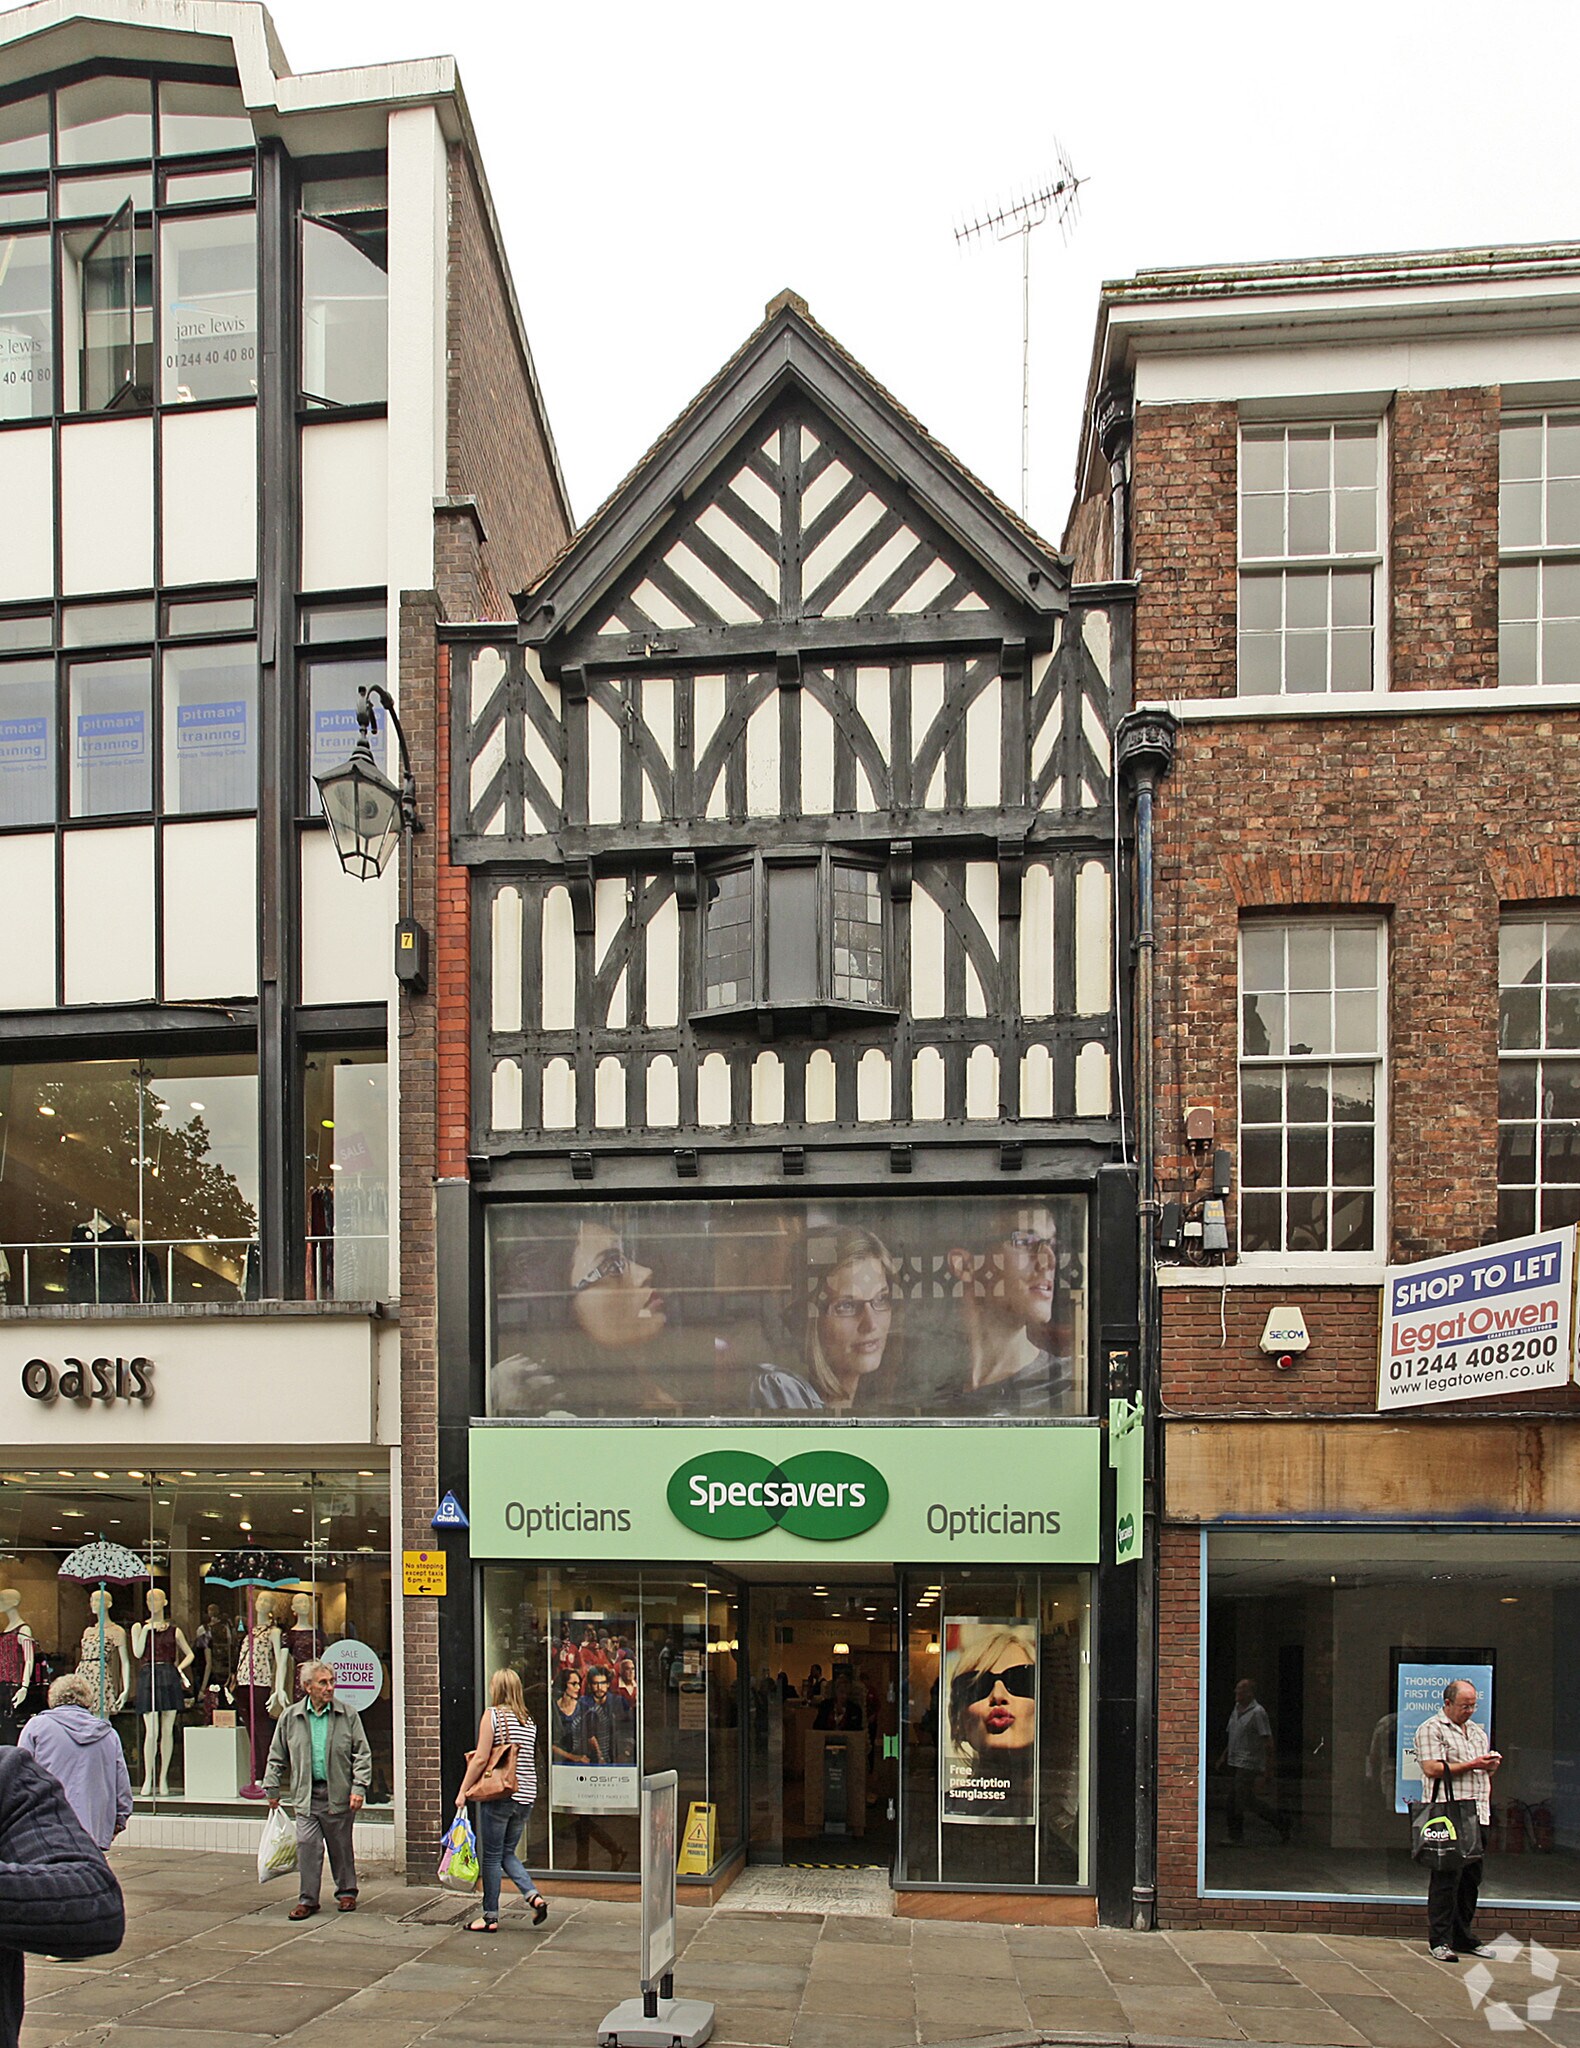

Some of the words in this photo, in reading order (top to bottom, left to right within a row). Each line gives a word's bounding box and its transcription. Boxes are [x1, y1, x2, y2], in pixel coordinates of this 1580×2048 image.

[174, 322, 206, 341] jane
[210, 315, 245, 333] lewis
[8, 337, 42, 354] lewis
[166, 353, 201, 368] 01244
[205, 351, 219, 364] 40
[223, 349, 237, 362] 40
[241, 347, 255, 361] 80
[3, 371, 17, 385] 40
[20, 370, 34, 383] 40
[37, 368, 51, 382] 80
[183, 728, 241, 742] training
[82, 738, 139, 750] training
[403, 935, 411, 946] 7
[340, 1142, 366, 1160] SALE
[1396, 1273, 1464, 1308] SHOP
[1471, 1264, 1507, 1292] TO
[1513, 1252, 1557, 1284] LET
[1269, 1330, 1304, 1340] SECOM
[1389, 1351, 1458, 1381] 01244
[1465, 1335, 1558, 1368] 408200
[689, 1475, 866, 1514] Specsavers
[437, 1515, 460, 1523] Chubb
[505, 1502, 631, 1537] Opticians
[927, 1504, 1061, 1541] Opticians
[417, 1562, 444, 1571] stopping
[405, 1570, 427, 1578] except
[428, 1570, 444, 1578] taxis
[340, 1650, 359, 1659] SALE
[333, 1662, 375, 1672] ONTINUES
[1404, 1677, 1450, 1687] THOMSON
[1404, 1689, 1429, 1699] FIRST
[1404, 1702, 1441, 1712] JOINING
[949, 1764, 973, 1775] Free
[949, 1777, 1011, 1790] prescription
[949, 1789, 1006, 1801] sunglasses
